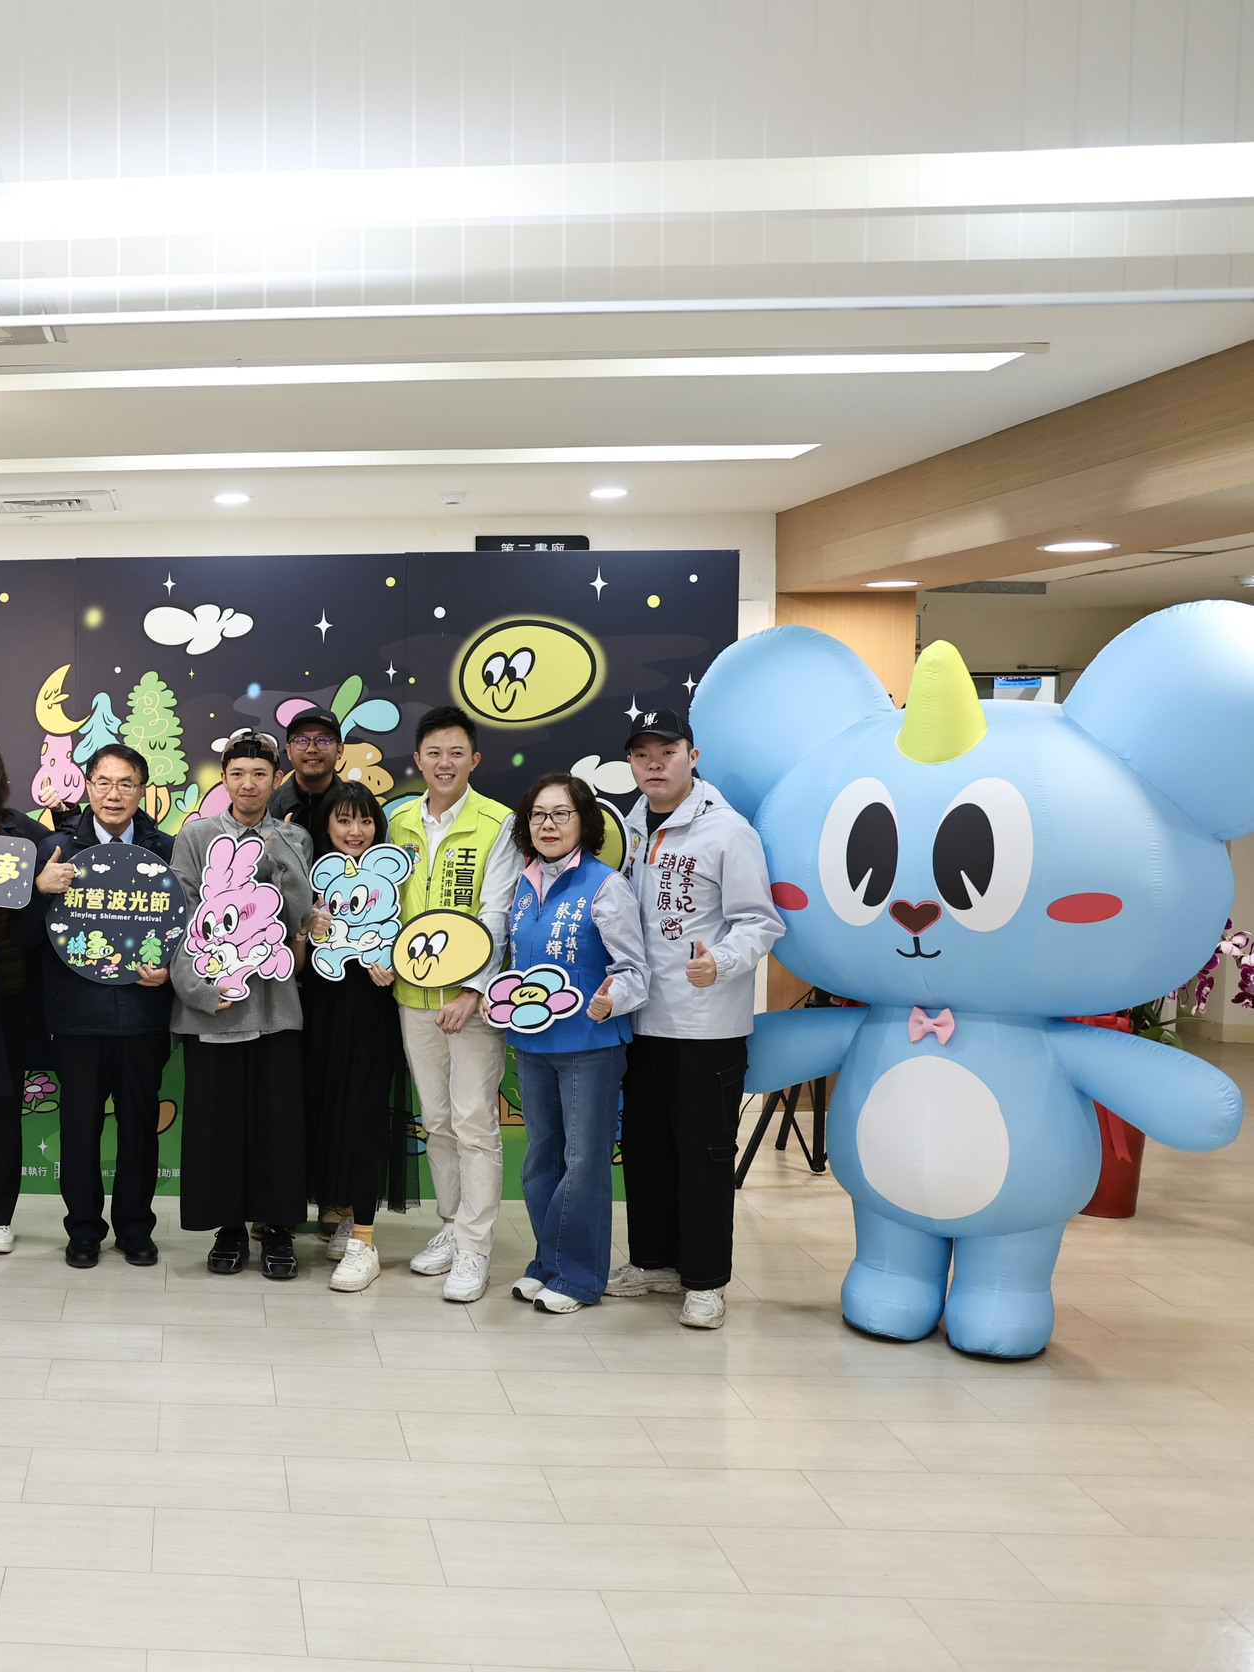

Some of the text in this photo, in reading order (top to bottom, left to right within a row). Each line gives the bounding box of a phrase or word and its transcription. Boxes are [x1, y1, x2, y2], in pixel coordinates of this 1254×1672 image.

[63, 886, 171, 914] 新營波光節
[443, 860, 455, 907] 台南市議員
[675, 854, 697, 913] 陳亭妃
[70, 911, 162, 923] Xinying Shimmer Festival
[545, 901, 571, 960] 蔡育輝
[565, 896, 588, 964] 台南市議員
